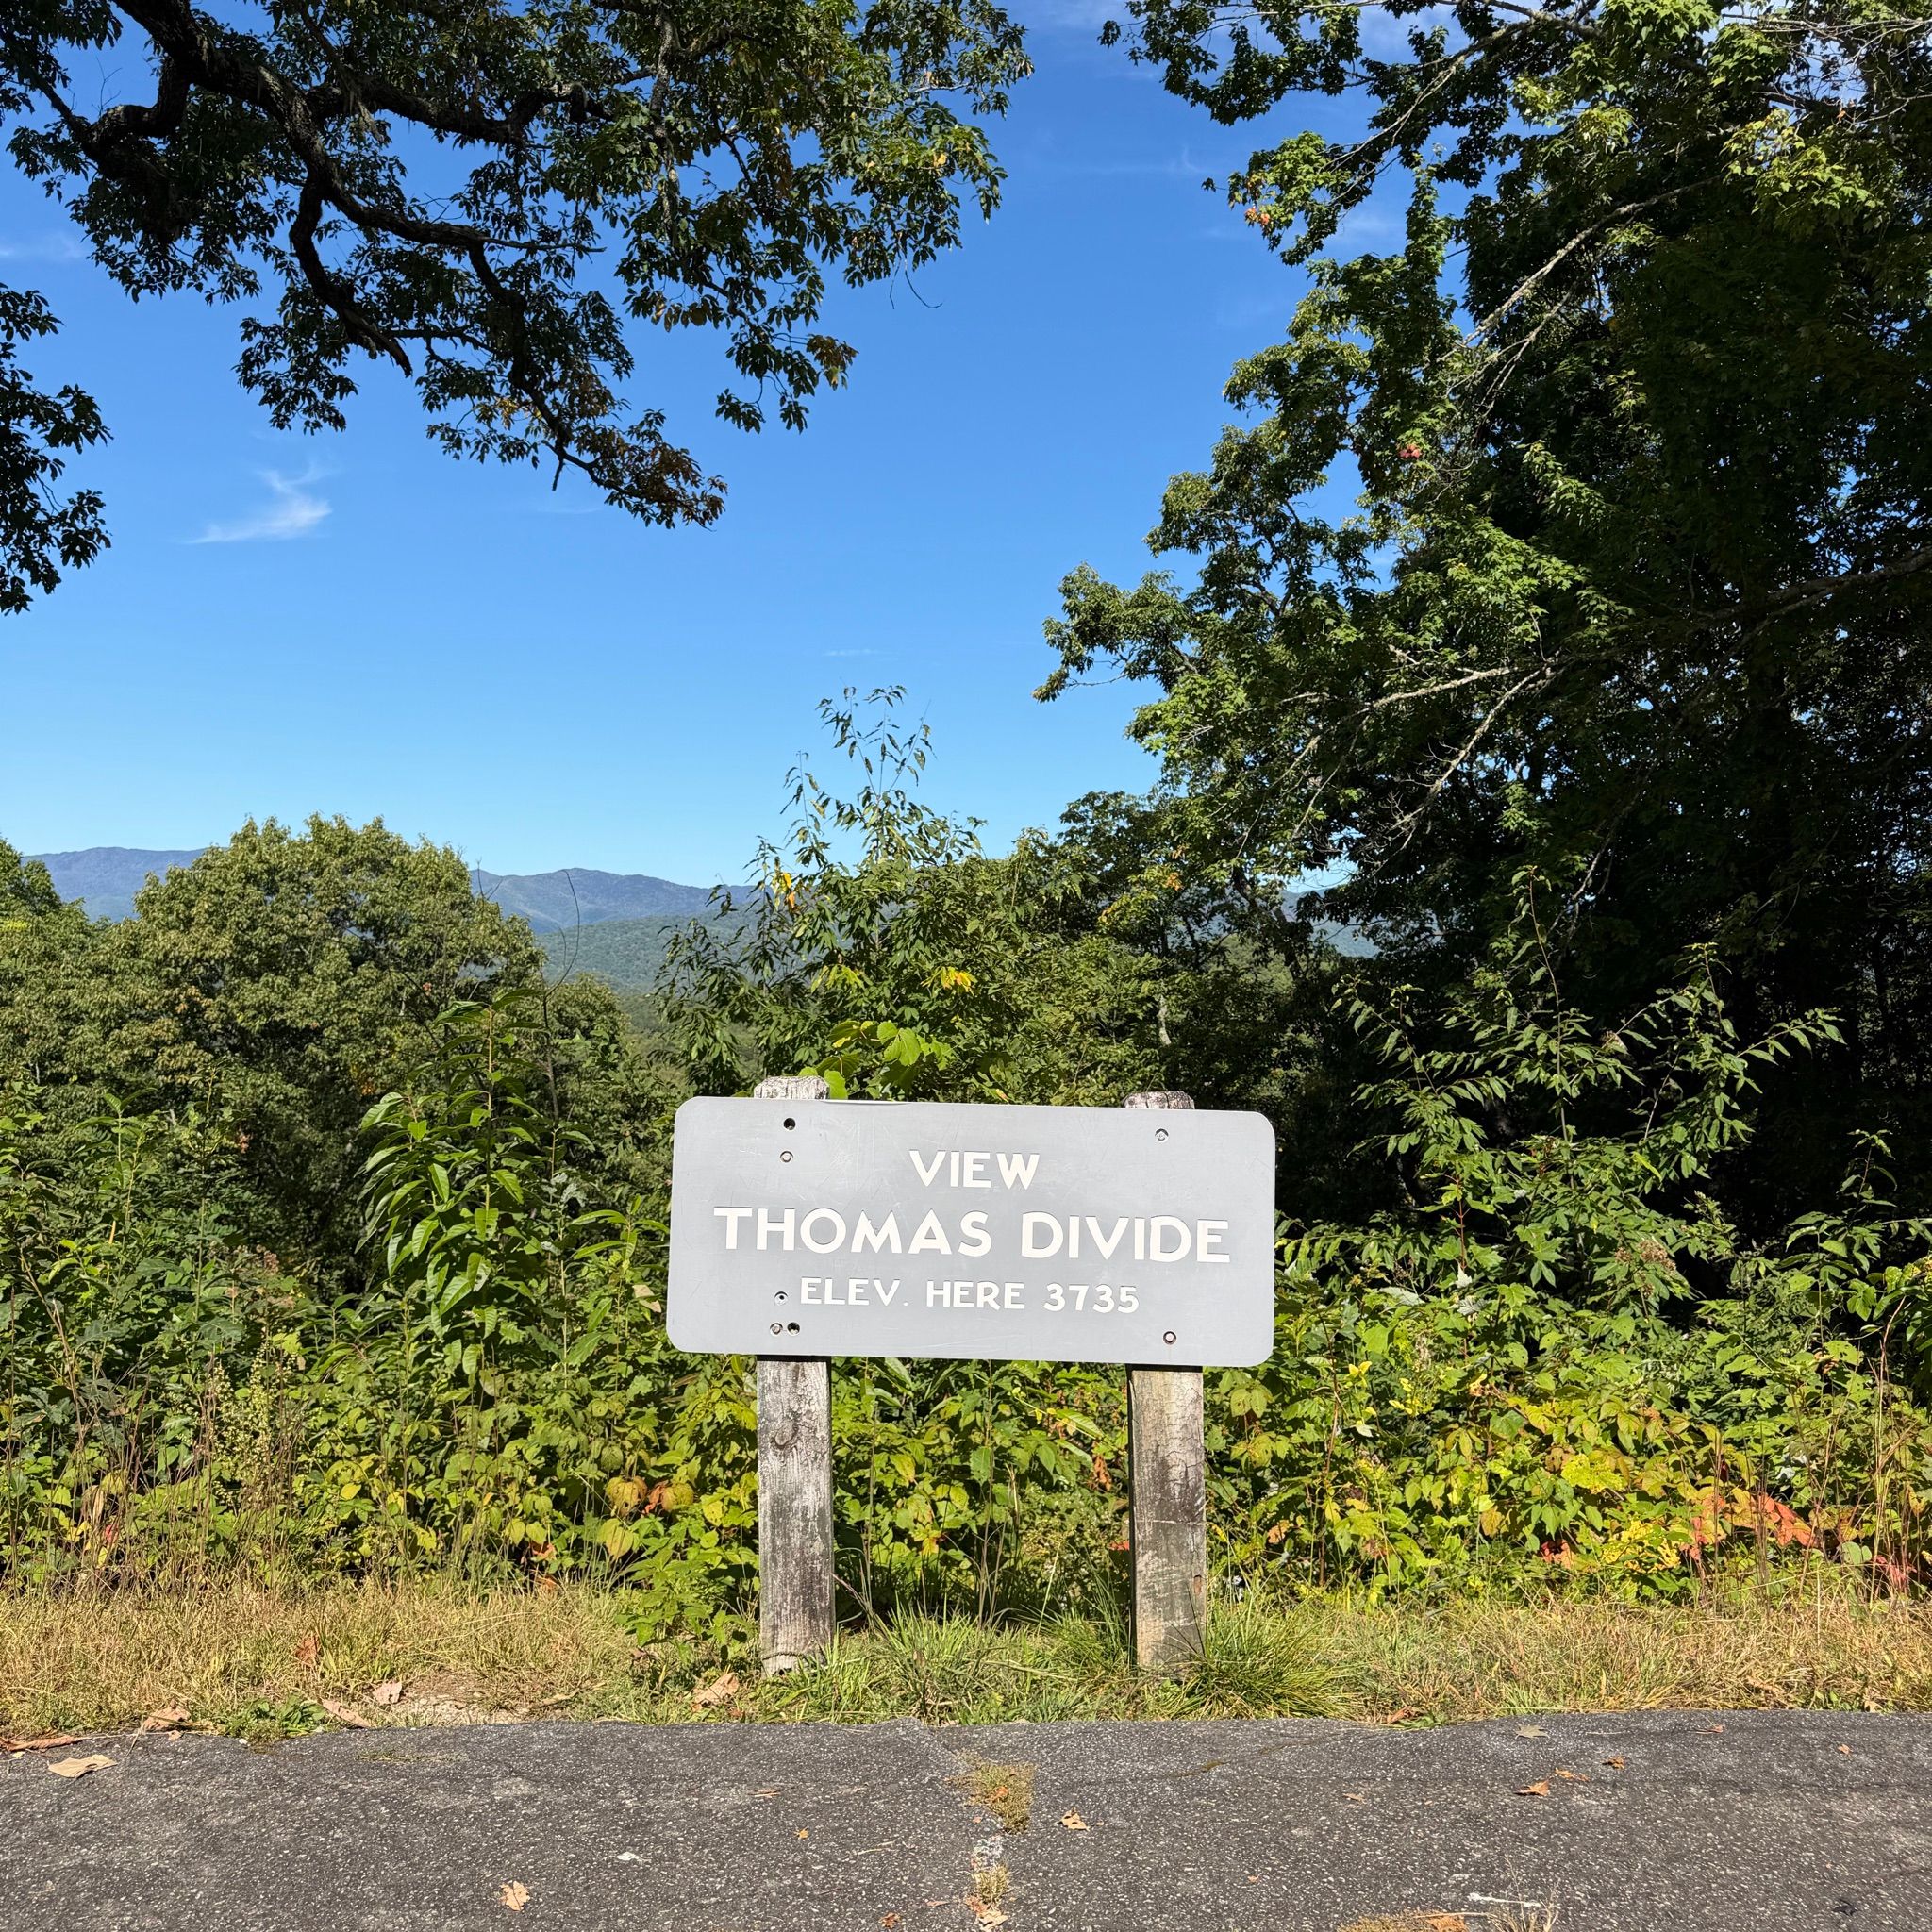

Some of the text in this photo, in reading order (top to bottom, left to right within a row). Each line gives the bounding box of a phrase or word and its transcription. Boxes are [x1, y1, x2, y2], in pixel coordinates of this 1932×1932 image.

[908, 1149, 1041, 1190] VIEW
[713, 1206, 1231, 1264] THOMAS DIVIDE
[799, 1276, 1140, 1314] ELEV. HERE 3735
